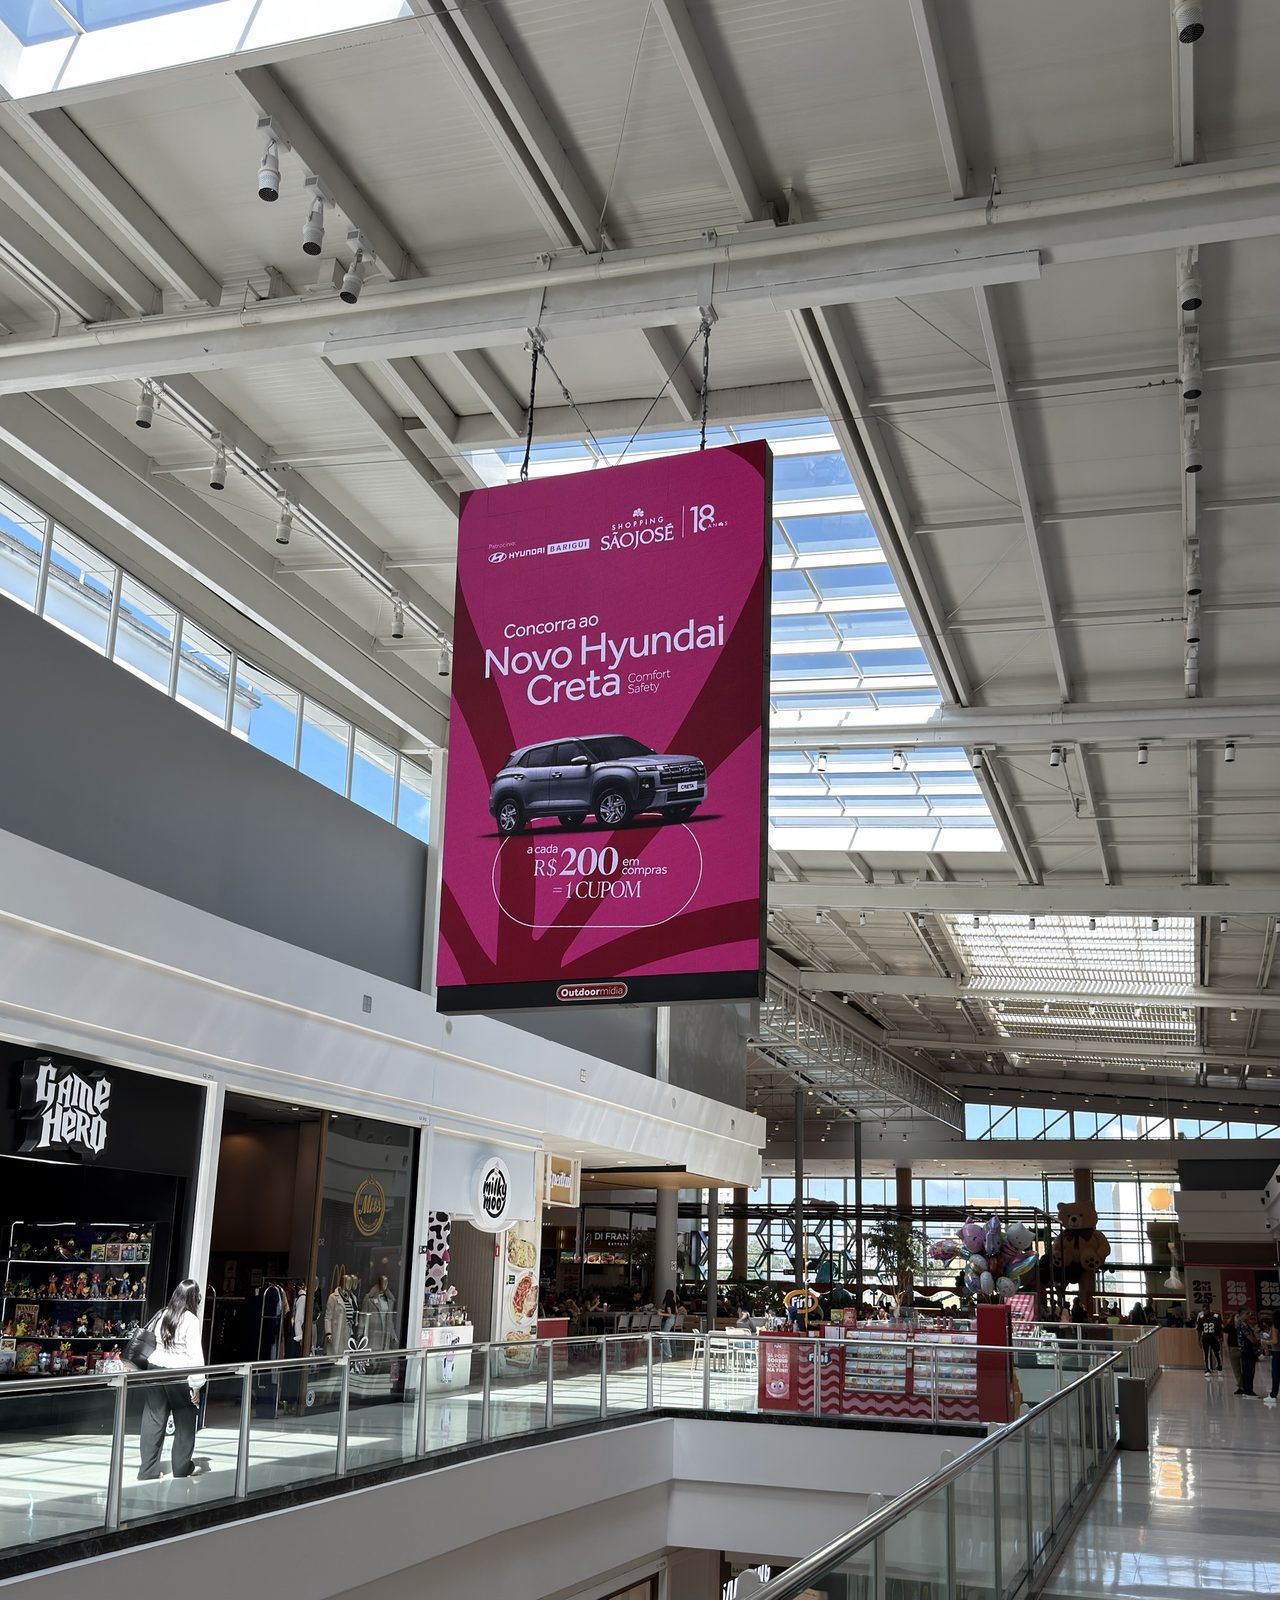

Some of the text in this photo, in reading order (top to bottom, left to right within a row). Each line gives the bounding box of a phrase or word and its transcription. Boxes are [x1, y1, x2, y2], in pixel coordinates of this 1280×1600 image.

[612, 517, 664, 531] SHOPPING
[690, 504, 715, 533] 18
[508, 541, 588, 559] HYUNDAI BARIGUI
[503, 615, 599, 639] Concorra ao
[484, 615, 725, 679] Novo Hyundai
[628, 669, 671, 684] Comfort
[527, 670, 621, 706] Creta
[628, 682, 660, 695] Safety
[526, 844, 559, 855] a cada
[533, 846, 619, 877] R$ 200
[622, 858, 640, 867] em
[621, 865, 668, 877] compras
[575, 880, 642, 899] CUPOM
[482, 1177, 508, 1202] milky
[483, 1195, 502, 1211] moo
[594, 1232, 604, 1241] DI
[1202, 1322, 1215, 1334] 22
[808, 1352, 829, 1363] Fni
